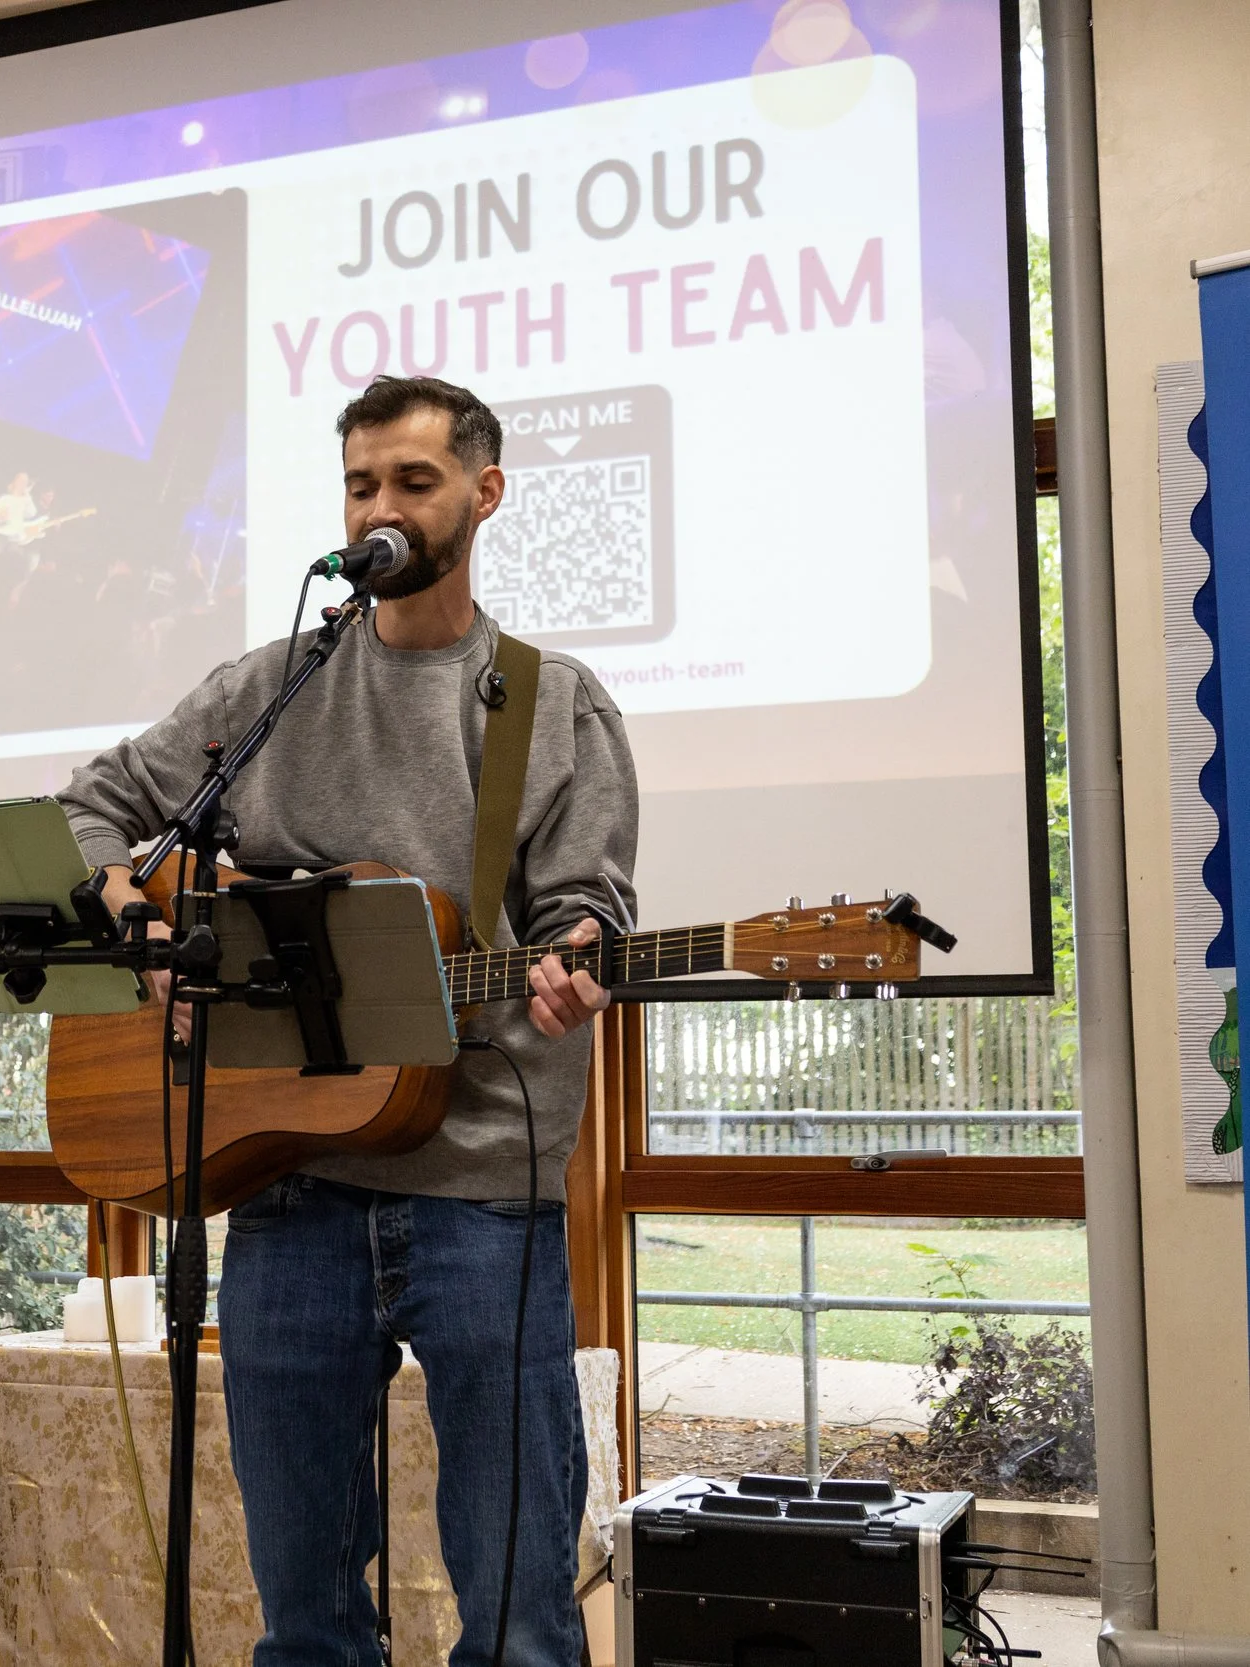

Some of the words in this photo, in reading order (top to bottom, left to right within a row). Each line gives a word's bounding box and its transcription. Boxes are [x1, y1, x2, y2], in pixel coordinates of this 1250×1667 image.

[338, 173, 532, 278] JOIN
[575, 137, 764, 241] OUR
[272, 282, 566, 397] YOUTH
[610, 236, 886, 356] TEAM
[497, 406, 580, 436] SCAN
[588, 400, 633, 427] ME
